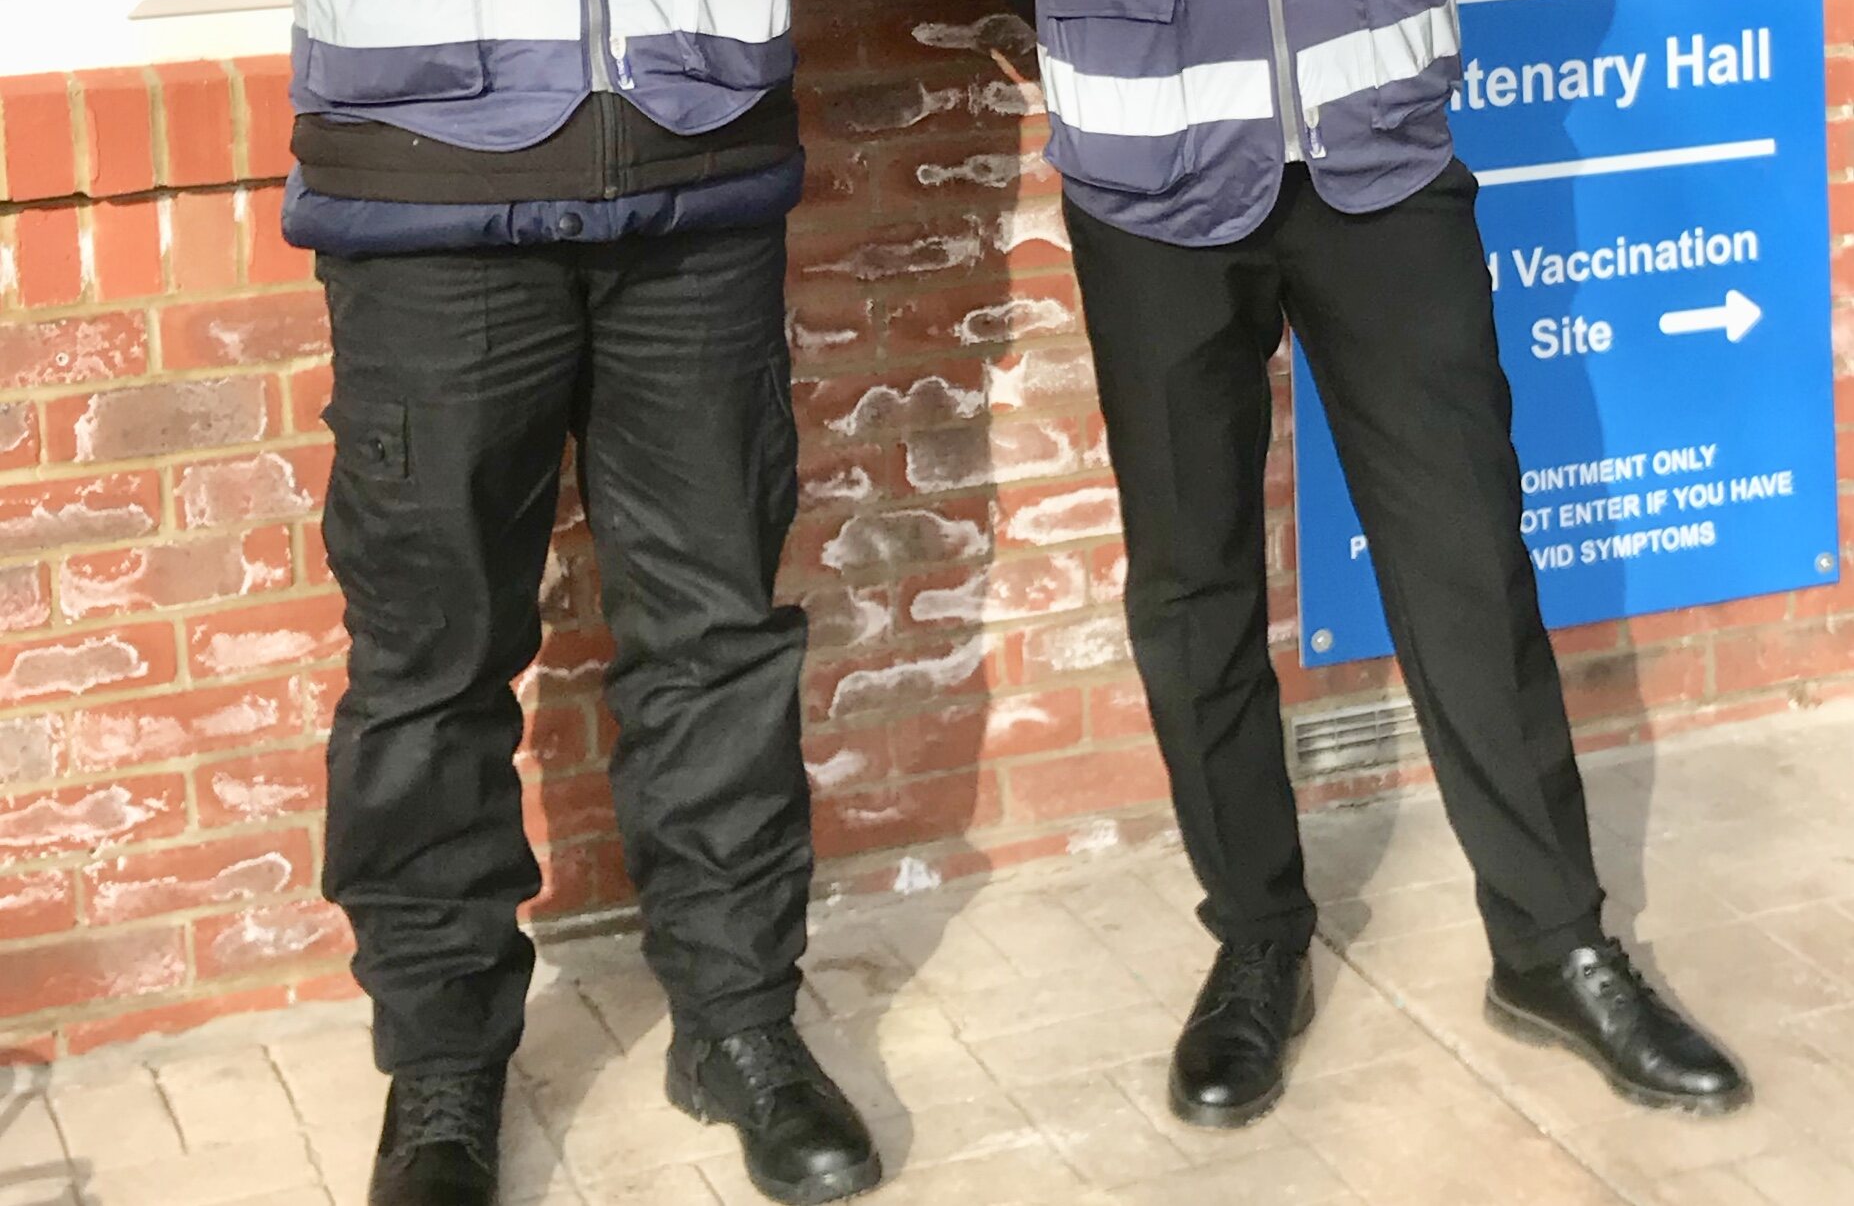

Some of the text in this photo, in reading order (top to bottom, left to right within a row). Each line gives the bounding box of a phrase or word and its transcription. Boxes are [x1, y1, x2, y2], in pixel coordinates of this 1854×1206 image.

[1451, 27, 1770, 111] tenary Hall
[1512, 226, 1760, 288] Vaccination
[1531, 315, 1613, 360] Site
[1521, 444, 1717, 494] OINTMENT ONLY
[1520, 470, 1794, 534] OT ENTER IF YOU HAVE
[1530, 520, 1717, 571] VID SYMPTOMS
